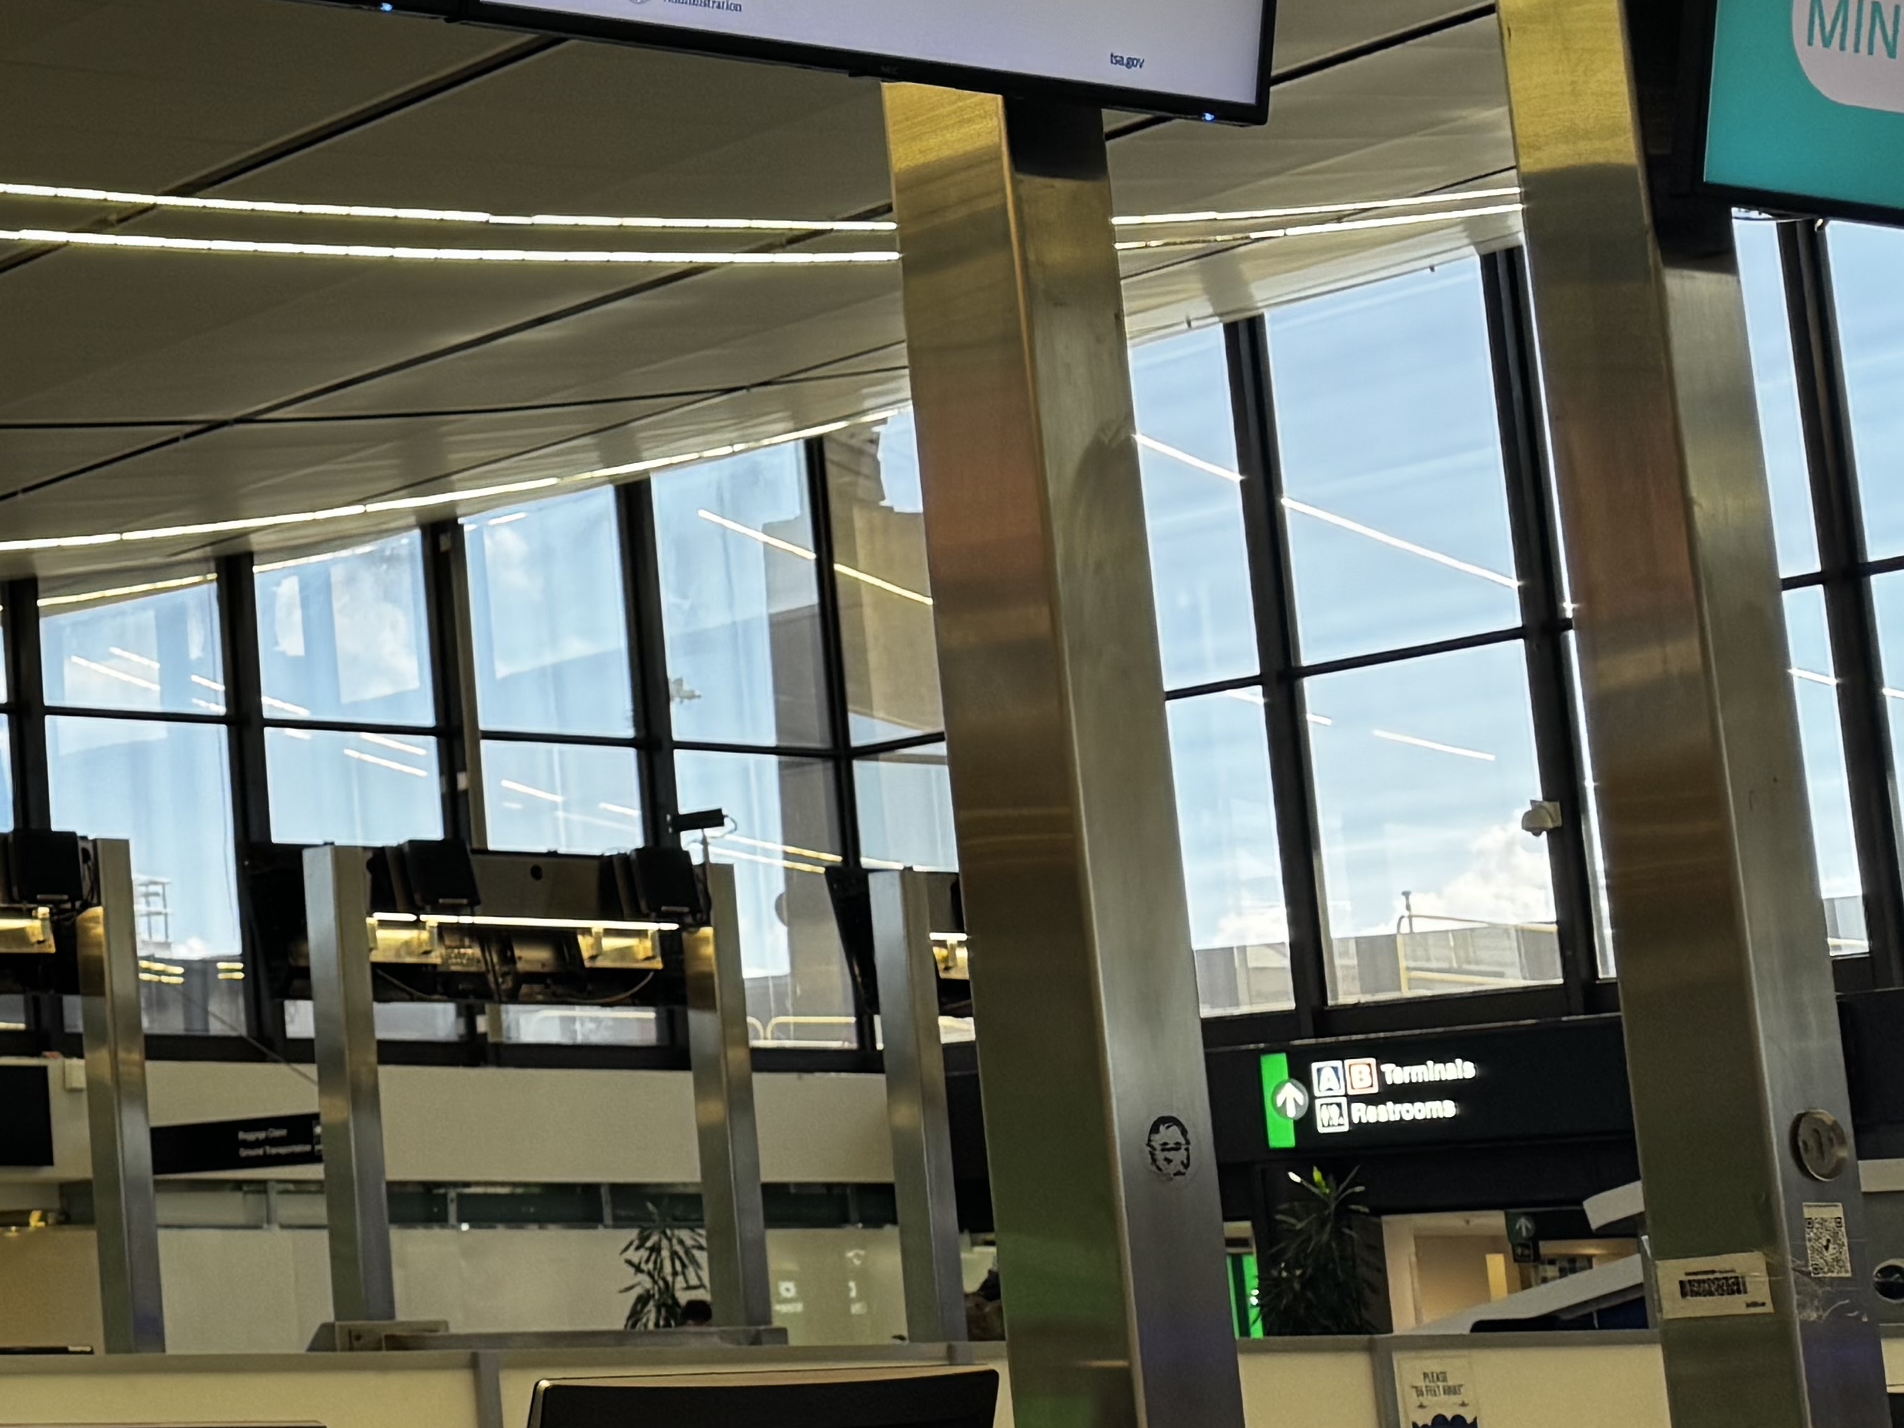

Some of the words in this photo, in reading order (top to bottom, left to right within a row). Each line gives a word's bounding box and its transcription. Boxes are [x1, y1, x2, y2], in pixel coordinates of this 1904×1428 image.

[1319, 1066, 1340, 1091] A
[1381, 1058, 1477, 1085] Terminals
[1350, 1100, 1457, 1124] Restrooms
